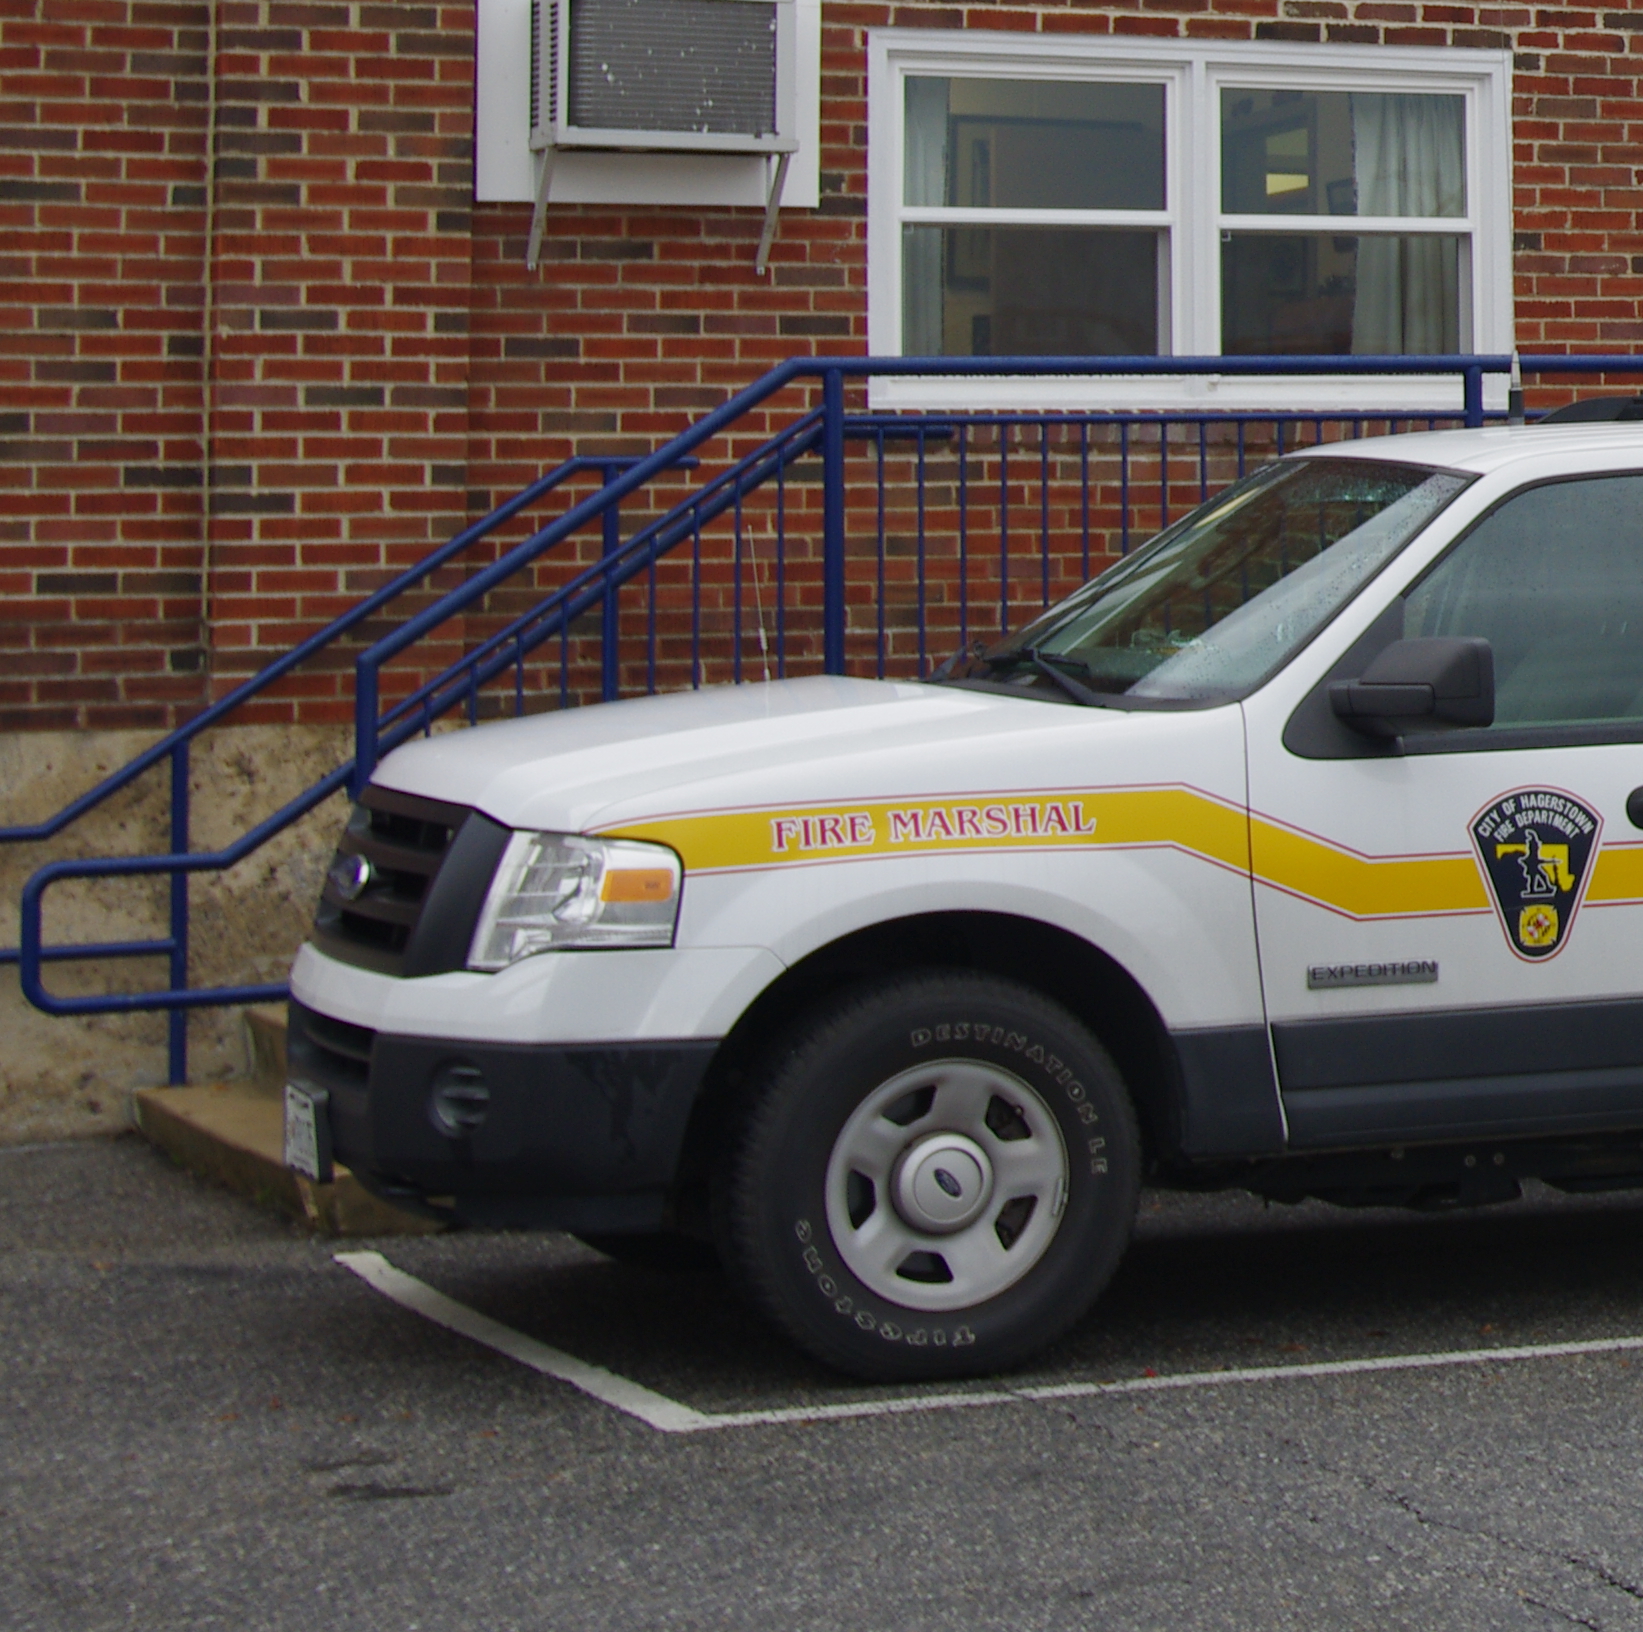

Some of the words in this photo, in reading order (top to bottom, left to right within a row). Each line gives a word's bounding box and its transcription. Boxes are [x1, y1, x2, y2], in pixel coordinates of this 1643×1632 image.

[771, 811, 875, 852] FIRE
[888, 801, 1096, 843] MARSHAL
[1477, 809, 1501, 838] CITY
[1502, 798, 1516, 816] OF
[1520, 793, 1594, 835] HAGERSTOWN
[1494, 824, 1516, 842] FIRE
[1515, 810, 1582, 839] DEPARTMENT
[1311, 960, 1438, 980] EXPEDITION
[911, 1023, 1098, 1125] DESTINATION
